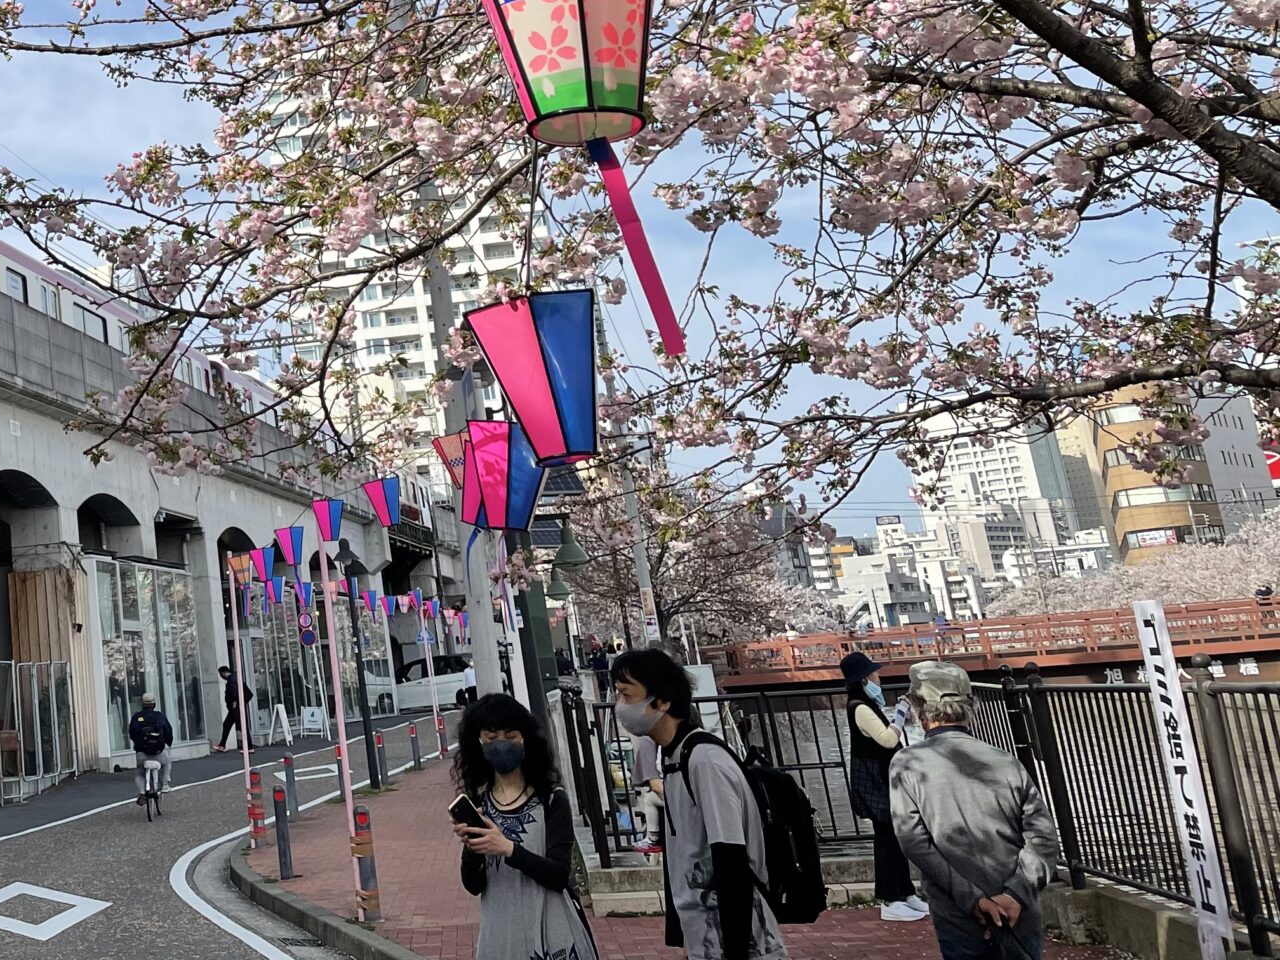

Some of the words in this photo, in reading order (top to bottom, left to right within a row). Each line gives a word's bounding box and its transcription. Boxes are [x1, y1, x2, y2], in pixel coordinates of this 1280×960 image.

[1142, 613, 1218, 915] ゴミ捨て禁止
